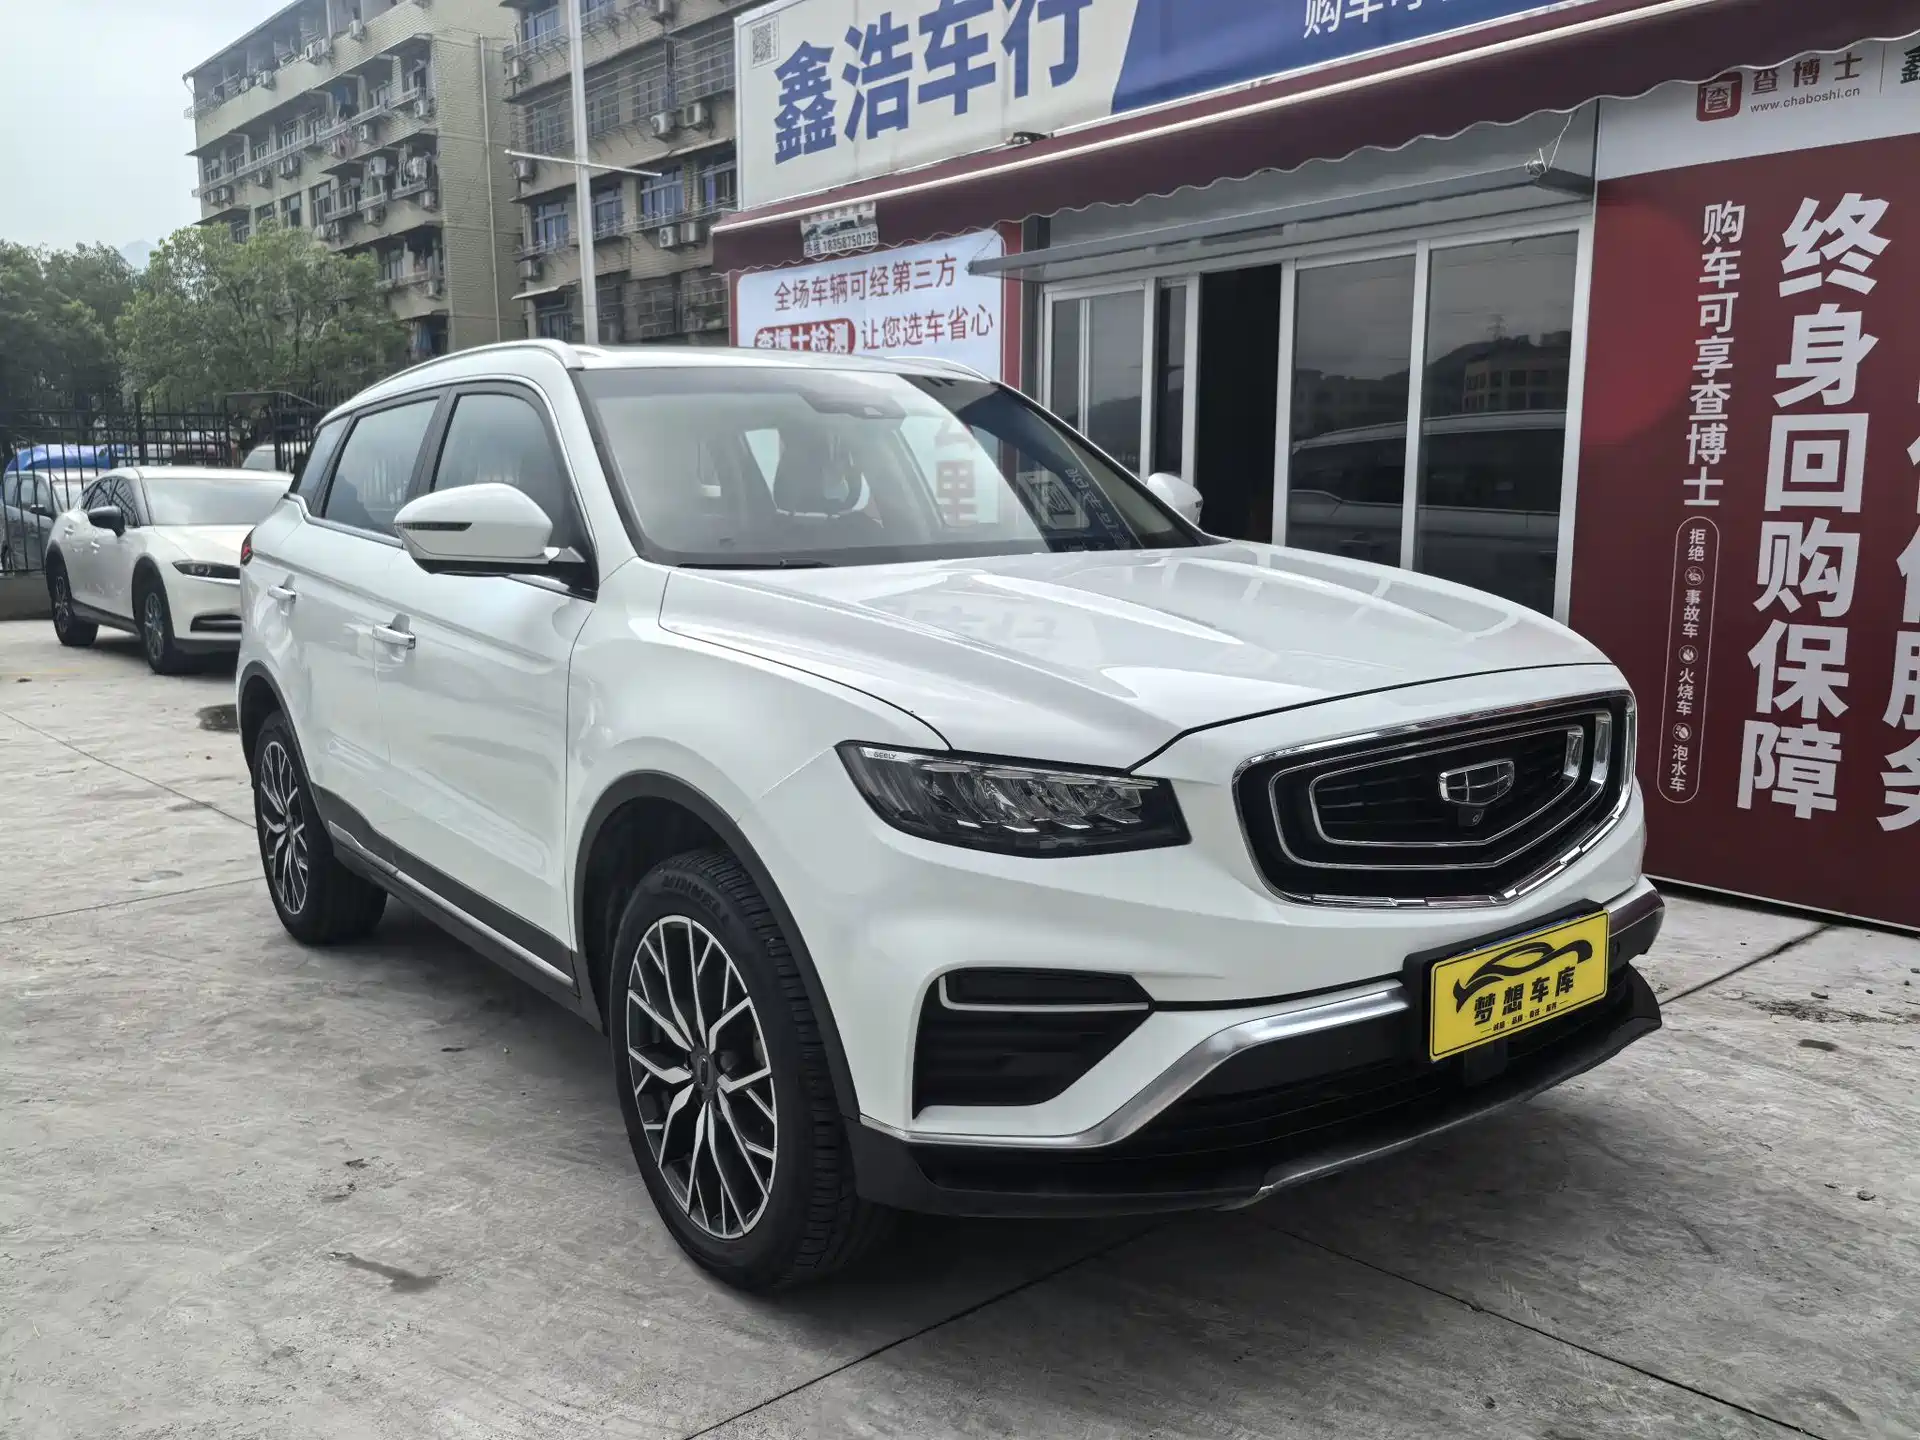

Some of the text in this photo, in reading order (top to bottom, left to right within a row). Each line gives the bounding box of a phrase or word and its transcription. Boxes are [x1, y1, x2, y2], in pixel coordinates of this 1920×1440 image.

[774, 0, 1093, 165] 鑫浩车行
[1750, 86, 1861, 113] www.chaboshi.cn
[1751, 52, 1863, 95] 查博士
[774, 252, 957, 311] 全场车辆可经第三方
[861, 303, 994, 351] 让您选车省心
[1683, 200, 1746, 506] 购车可享查博士
[1737, 192, 1891, 821] 终身回购保障
[1669, 528, 1706, 792] 拒绝 事故车 火烧车 泡水车
[873, 751, 897, 760] GEELY
[1475, 966, 1576, 1025] 梦想车库
